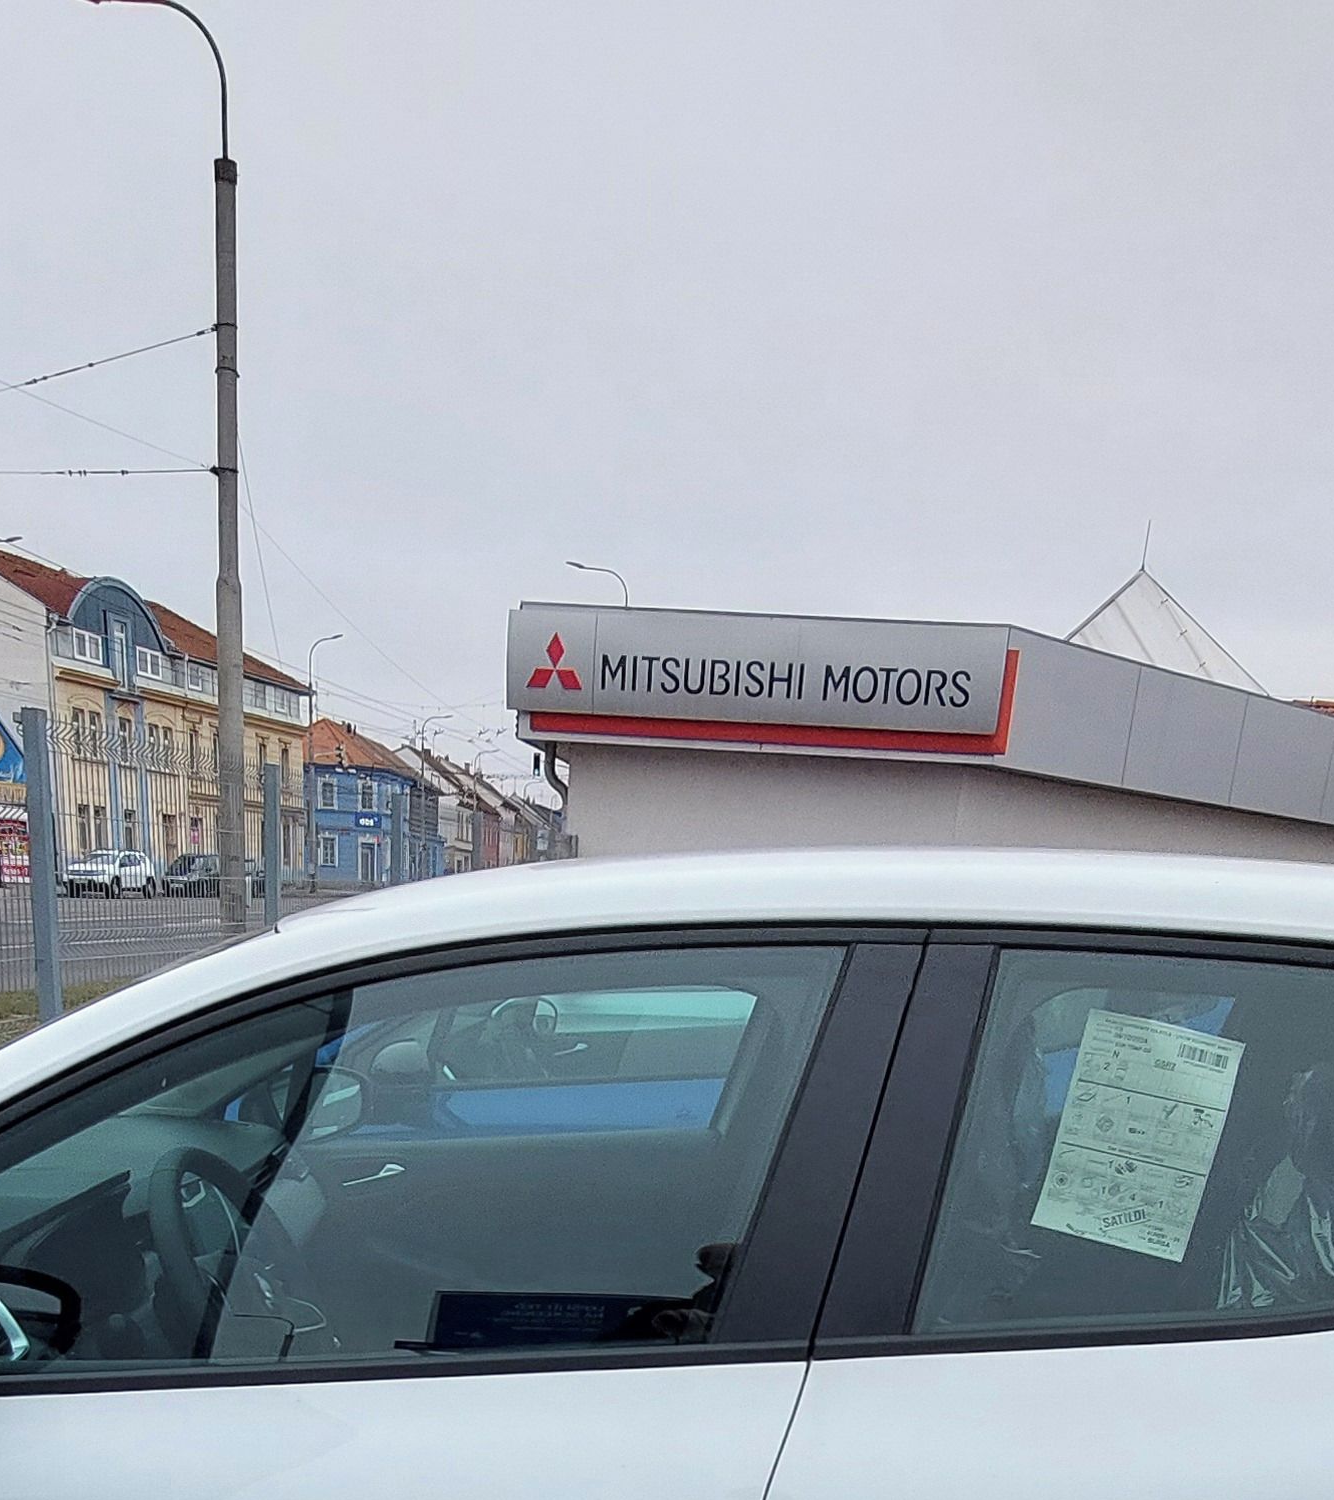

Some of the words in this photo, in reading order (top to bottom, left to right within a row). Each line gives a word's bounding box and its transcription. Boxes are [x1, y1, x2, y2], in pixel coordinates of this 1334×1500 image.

[600, 654, 805, 701] MITSUBISHI
[821, 664, 972, 708] MOTORS
[1102, 1208, 1147, 1229] SATILDI
